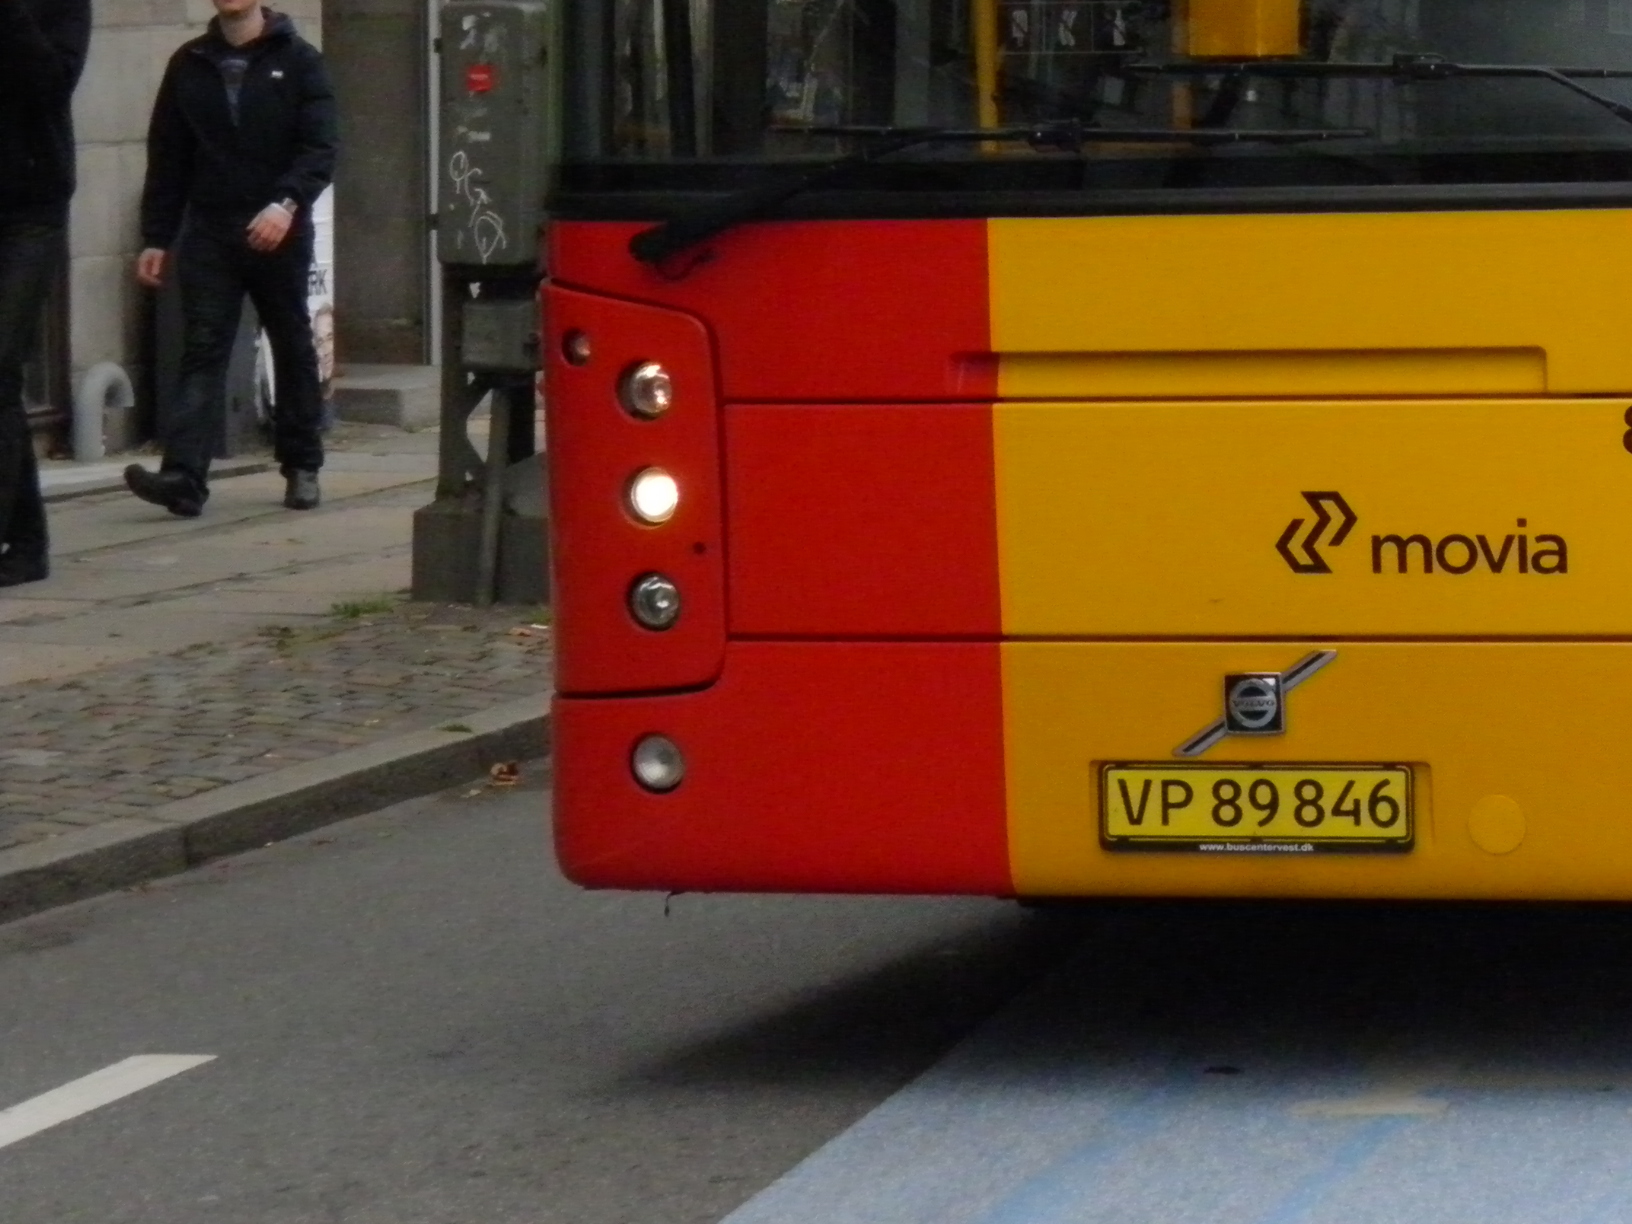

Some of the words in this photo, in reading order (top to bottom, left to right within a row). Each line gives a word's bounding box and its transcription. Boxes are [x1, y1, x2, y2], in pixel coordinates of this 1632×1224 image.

[1371, 519, 1567, 574] movia
[1118, 779, 1194, 826] VP
[1211, 778, 1280, 827] 89
[1293, 778, 1400, 828] 846
[1199, 840, 1314, 853] www.buscentervest.dk
